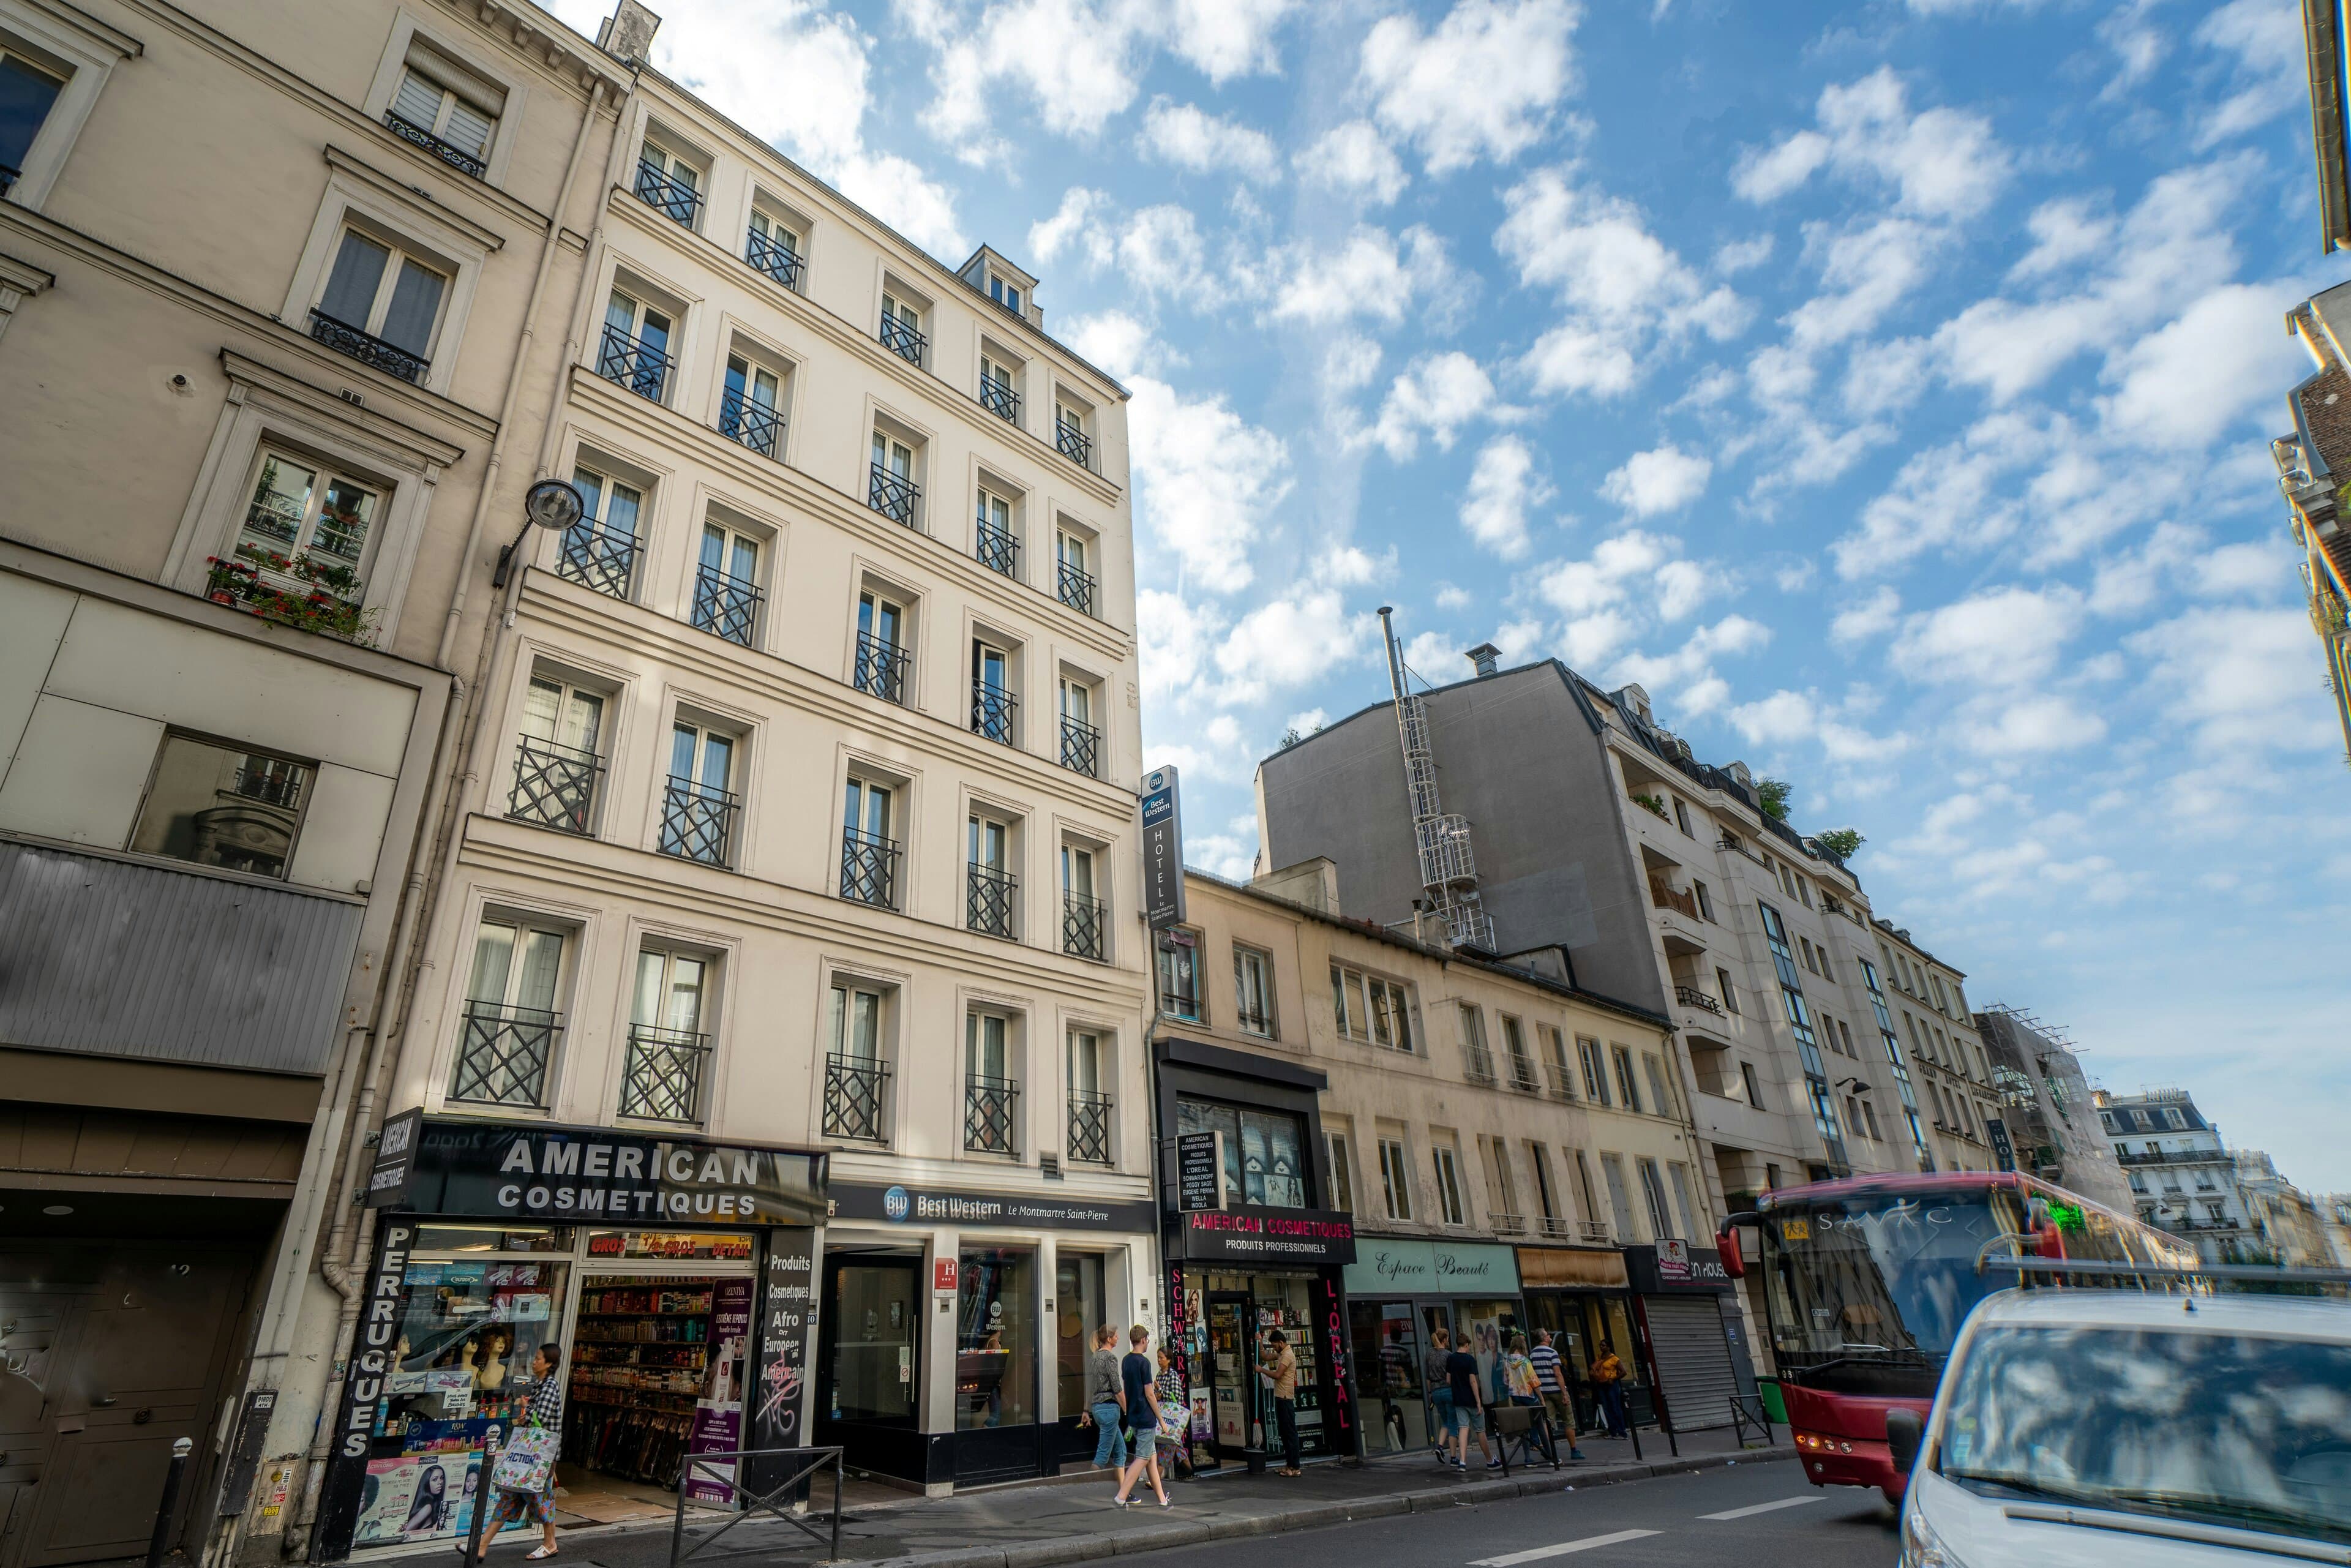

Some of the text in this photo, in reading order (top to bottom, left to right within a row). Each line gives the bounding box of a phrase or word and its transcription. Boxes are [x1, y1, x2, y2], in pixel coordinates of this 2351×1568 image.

[1150, 775, 1162, 788] BW
[1145, 804, 1171, 818] Western
[1150, 798, 1164, 809] Best
[1155, 830, 1164, 898] HOTEL
[1150, 904, 1174, 916] Montmartre
[1151, 910, 1174, 921] Saint-Pierre
[380, 1117, 413, 1157] AMERICAN
[1182, 1142, 1213, 1150] COSMETIQUES
[500, 1139, 758, 1185] AMERICAN
[371, 1166, 405, 1191] COSMETIQUES
[498, 1185, 755, 1215] COSMETIQUES
[887, 1195, 1109, 1221] BW Best Western Le Montmartre Saint-Pierre
[1192, 1213, 1352, 1238] AMERICAN COSMETIQUES
[591, 1238, 626, 1253] GROS
[664, 1240, 696, 1254] GROS
[712, 1243, 749, 1256] DETAIL
[1226, 1239, 1325, 1253] PRODUITS PROFESSIONNELS
[771, 1255, 811, 1270] Produits
[945, 1264, 955, 1275] H
[1375, 1251, 1489, 1281] Espace Beauté
[770, 1283, 809, 1302] Cosmetiques
[772, 1311, 798, 1327] Afro
[343, 1227, 410, 1457] PERRUQUES
[1327, 1279, 1349, 1429] L'OREAL
[505, 1452, 535, 1465] ACTION
